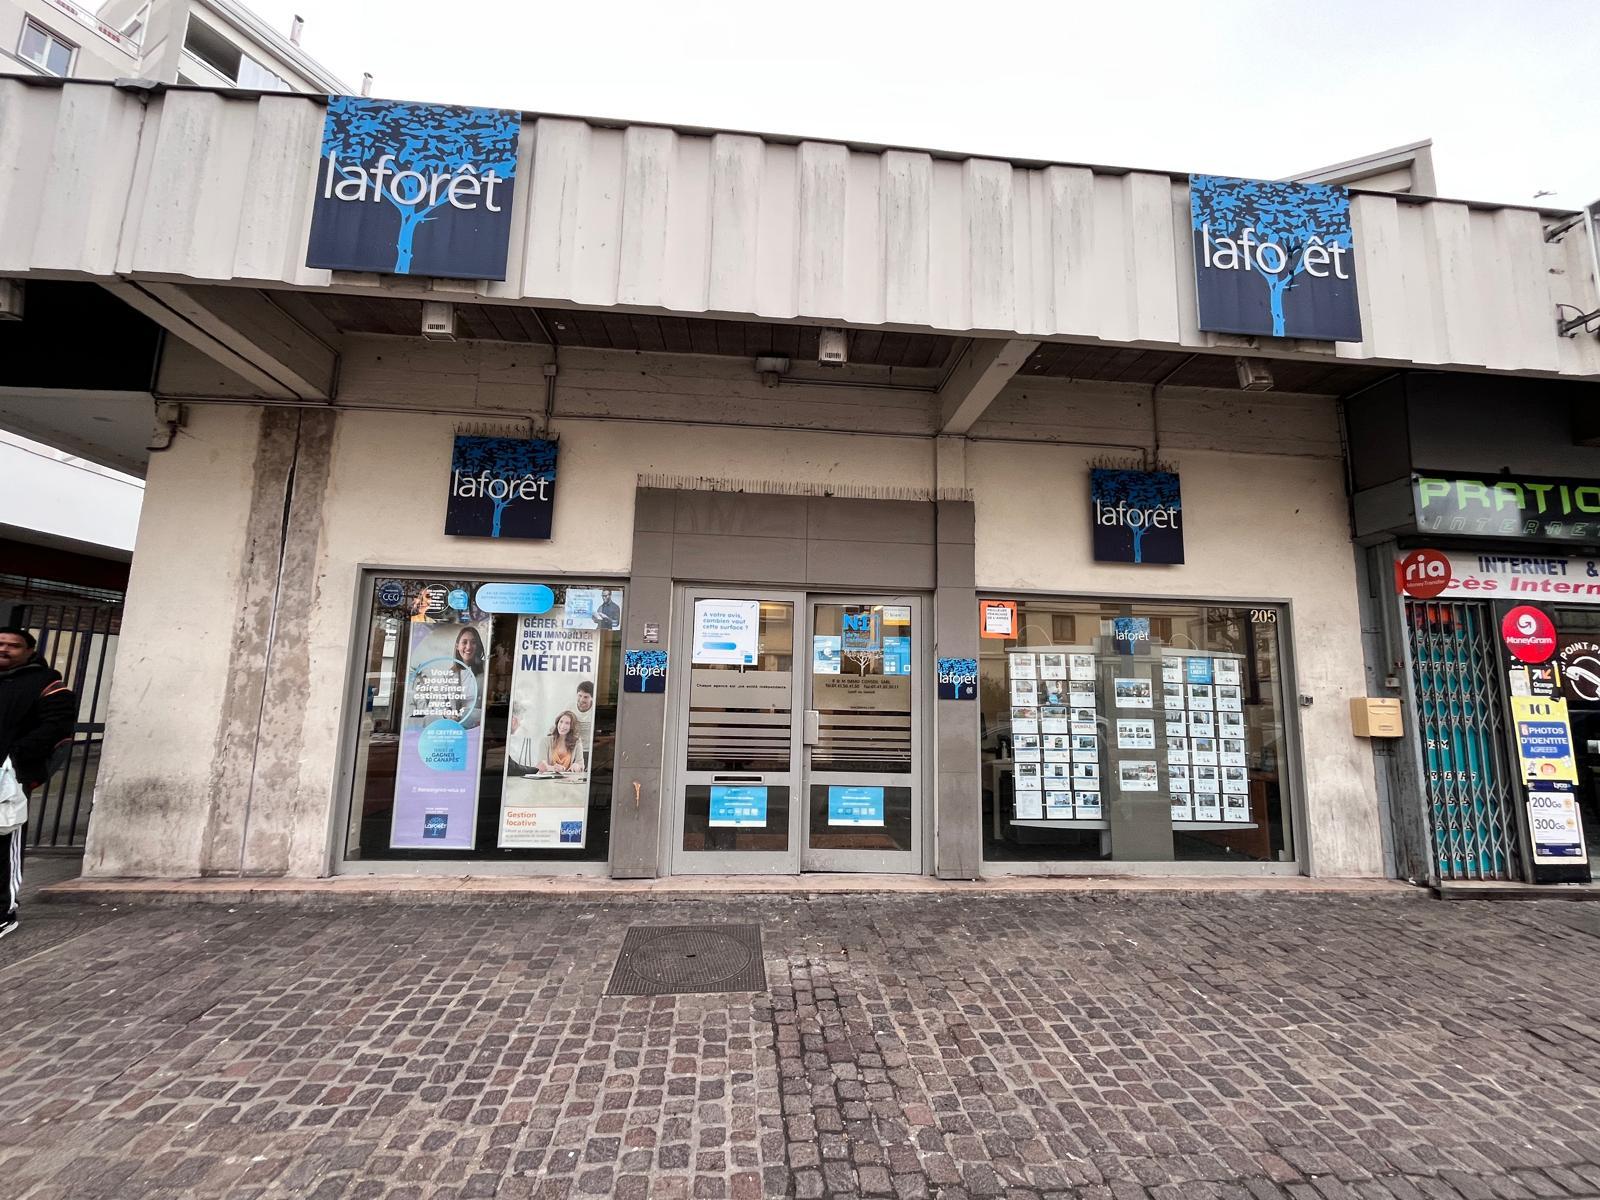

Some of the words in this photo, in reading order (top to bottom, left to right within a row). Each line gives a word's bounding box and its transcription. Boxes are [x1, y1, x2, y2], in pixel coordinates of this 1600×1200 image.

[324, 150, 503, 212] laforêt
[453, 469, 549, 501] laforêt
[1096, 499, 1178, 529] laforêt
[1432, 516, 1600, 537] INTERNE
[1406, 554, 1445, 580] ria
[1478, 556, 1568, 576] INTERNET
[1587, 561, 1599, 578] &
[1446, 576, 1498, 590] cès
[524, 617, 558, 628] GÉRER
[1250, 609, 1276, 623] 205
[523, 630, 543, 638] BIEN
[545, 631, 593, 639] IMMOBILIER
[1115, 629, 1150, 641] laforêt
[522, 640, 555, 651] C'EST
[556, 641, 593, 651] NOTRE
[1560, 642, 1589, 660] POINT
[521, 651, 592, 673] MÉTIER
[625, 664, 666, 678] laforêt
[424, 677, 459, 685] pouvez
[939, 672, 977, 685] laforêt
[413, 692, 467, 700] estimation
[1529, 727, 1564, 735] PHOTOS
[507, 811, 537, 819] Gestion
[506, 819, 537, 827] locative
